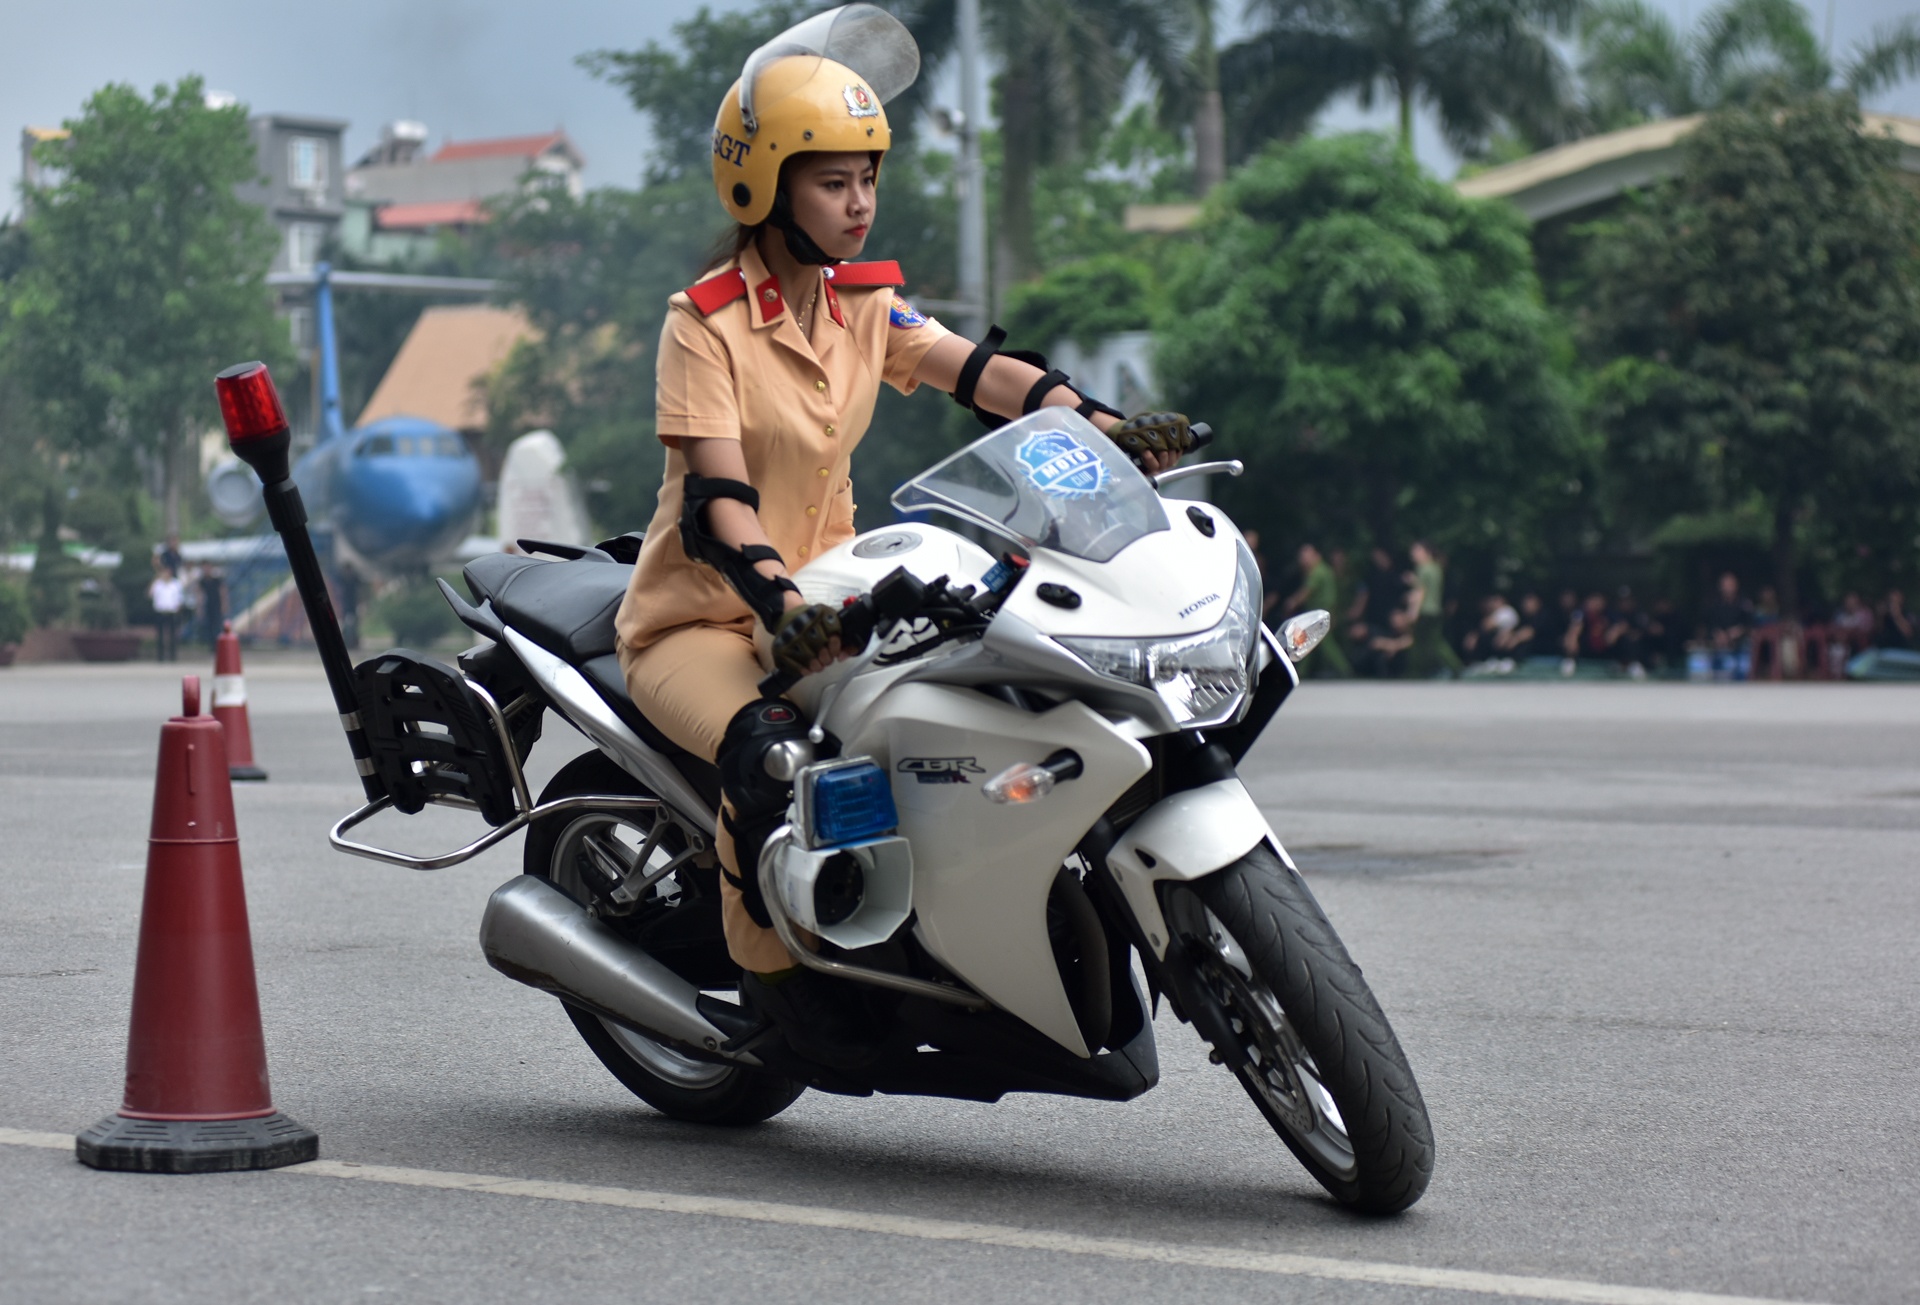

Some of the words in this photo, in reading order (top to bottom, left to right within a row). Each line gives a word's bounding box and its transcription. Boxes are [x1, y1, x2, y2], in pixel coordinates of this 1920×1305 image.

[1041, 450, 1089, 480] MOTO
[1178, 592, 1221, 619] HONDA
[897, 757, 987, 774] CBR
